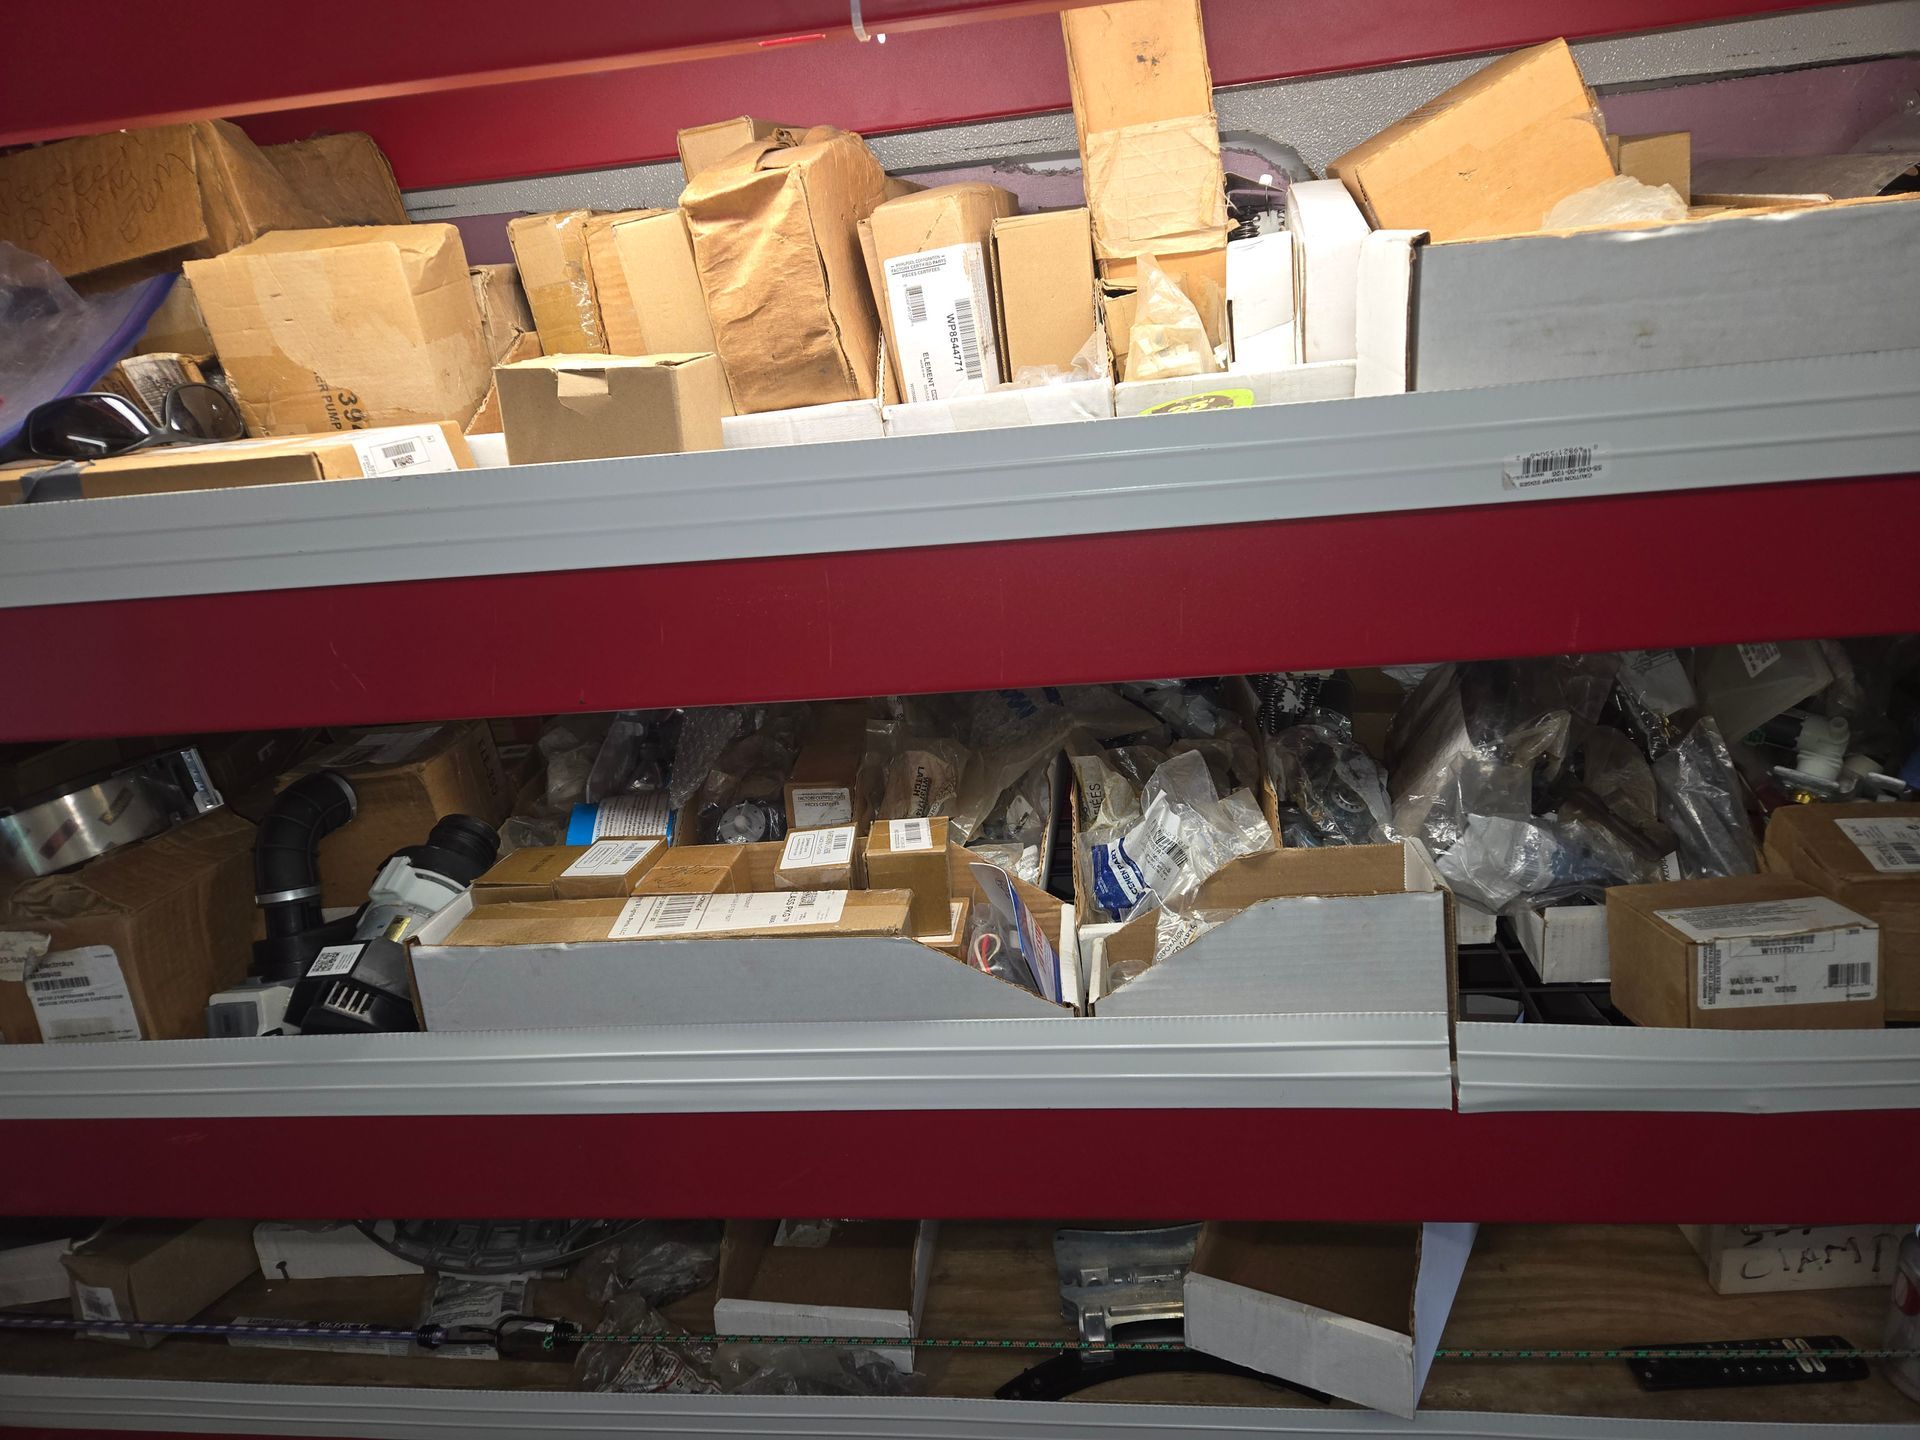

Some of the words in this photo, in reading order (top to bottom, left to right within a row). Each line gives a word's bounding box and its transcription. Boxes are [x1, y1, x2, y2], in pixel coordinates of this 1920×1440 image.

[932, 258, 947, 266] PARTS
[946, 313, 964, 373] WP8544771
[922, 351, 935, 388] ELEMENT
[321, 395, 342, 430] PUMP
[1565, 472, 1593, 481] CAUTION
[913, 766, 925, 797] LATCH
